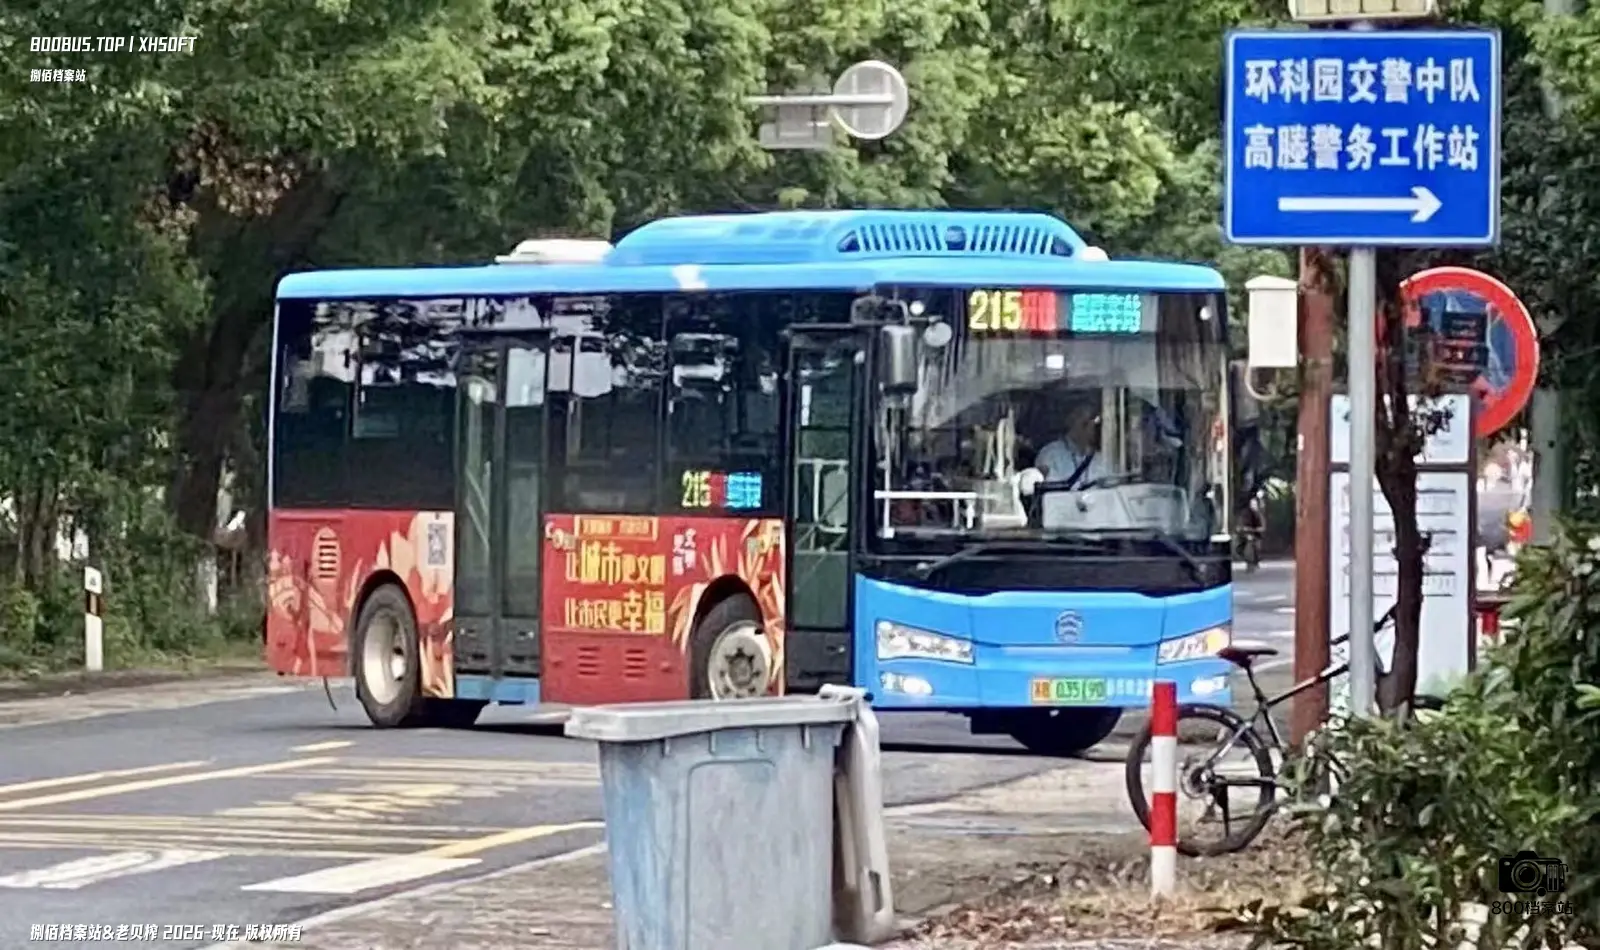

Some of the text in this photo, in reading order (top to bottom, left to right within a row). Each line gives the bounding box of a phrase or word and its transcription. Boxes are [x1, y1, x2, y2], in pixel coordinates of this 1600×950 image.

[1244, 57, 1480, 104] 环科园交警中队
